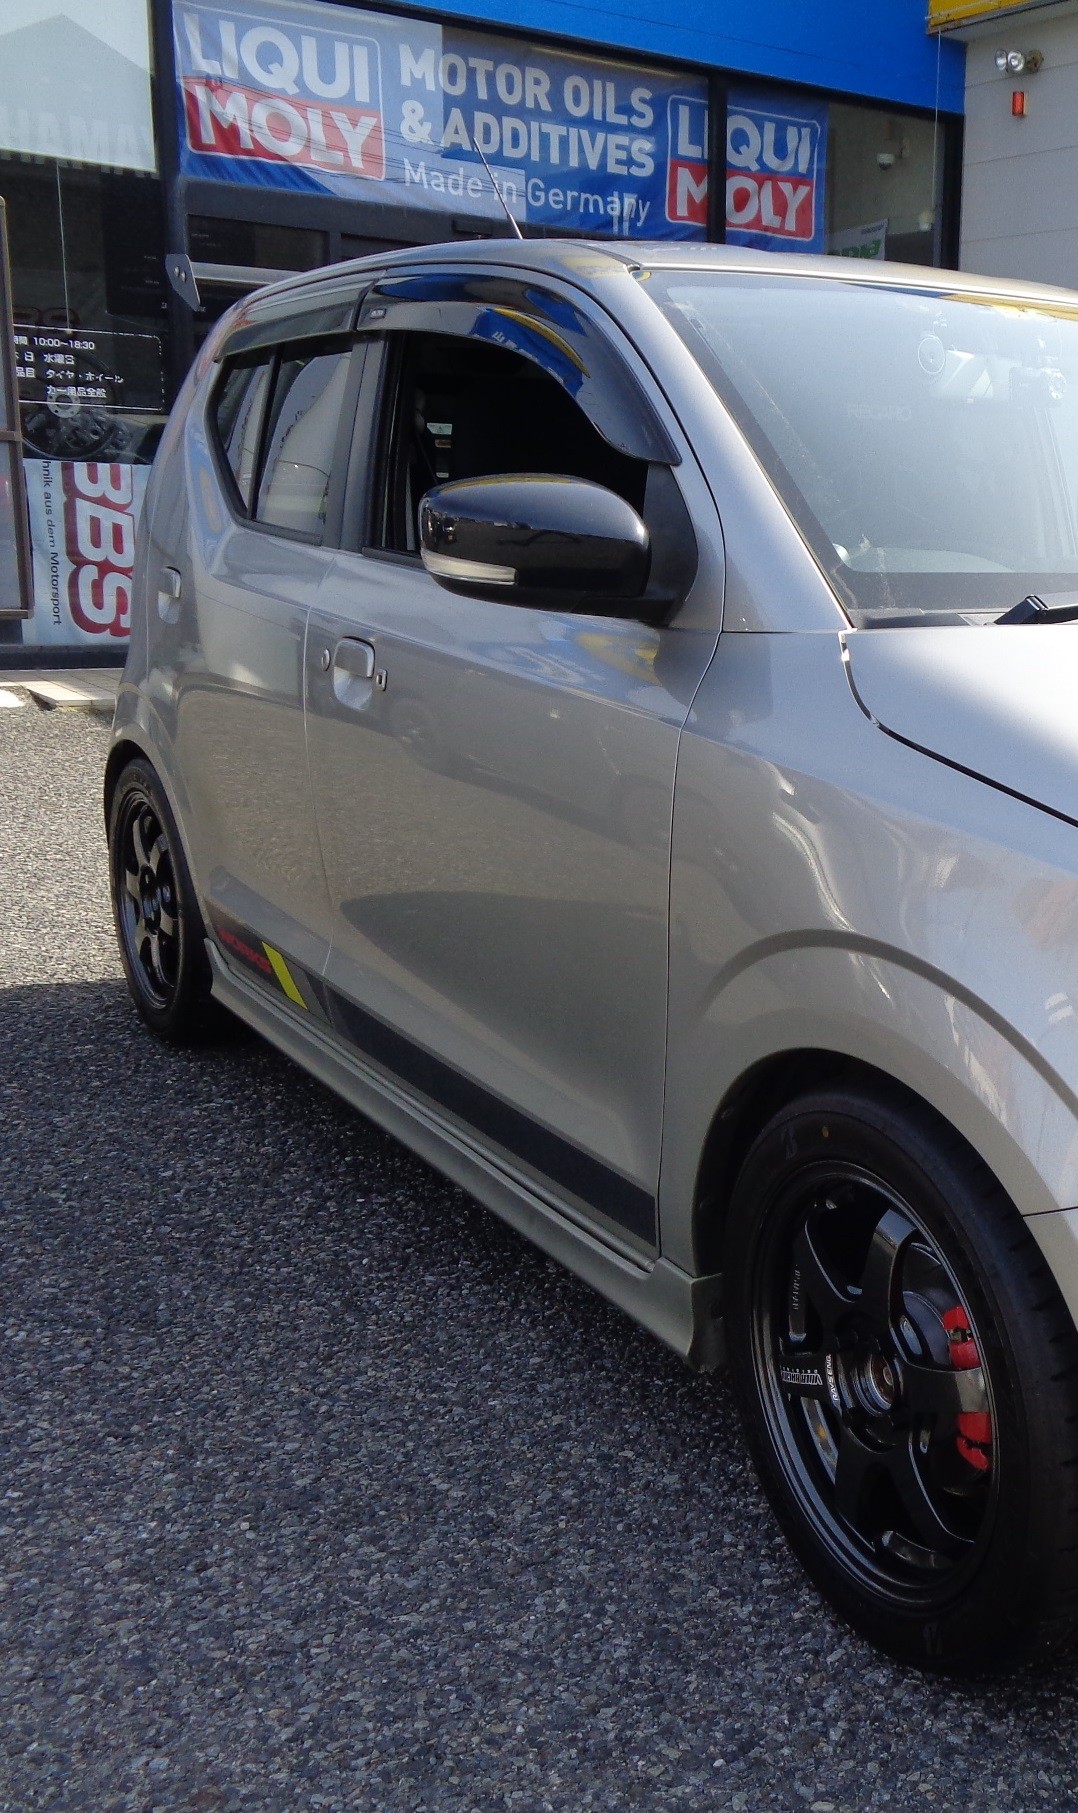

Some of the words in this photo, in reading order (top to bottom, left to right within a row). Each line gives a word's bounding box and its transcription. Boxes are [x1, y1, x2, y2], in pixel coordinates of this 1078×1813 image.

[184, 13, 371, 103] LIQUI
[399, 43, 551, 112] MOTOR
[563, 75, 655, 128] OILS
[194, 85, 379, 170] MOLY
[399, 99, 433, 147] &
[440, 107, 656, 178] ADDITIVES
[403, 158, 483, 198] Made
[493, 172, 517, 204] in
[527, 178, 651, 227] Germany
[43, 492, 53, 515] aus
[46, 516, 56, 549] dem
[65, 462, 135, 632] BBS
[50, 551, 62, 626] Motorsport
